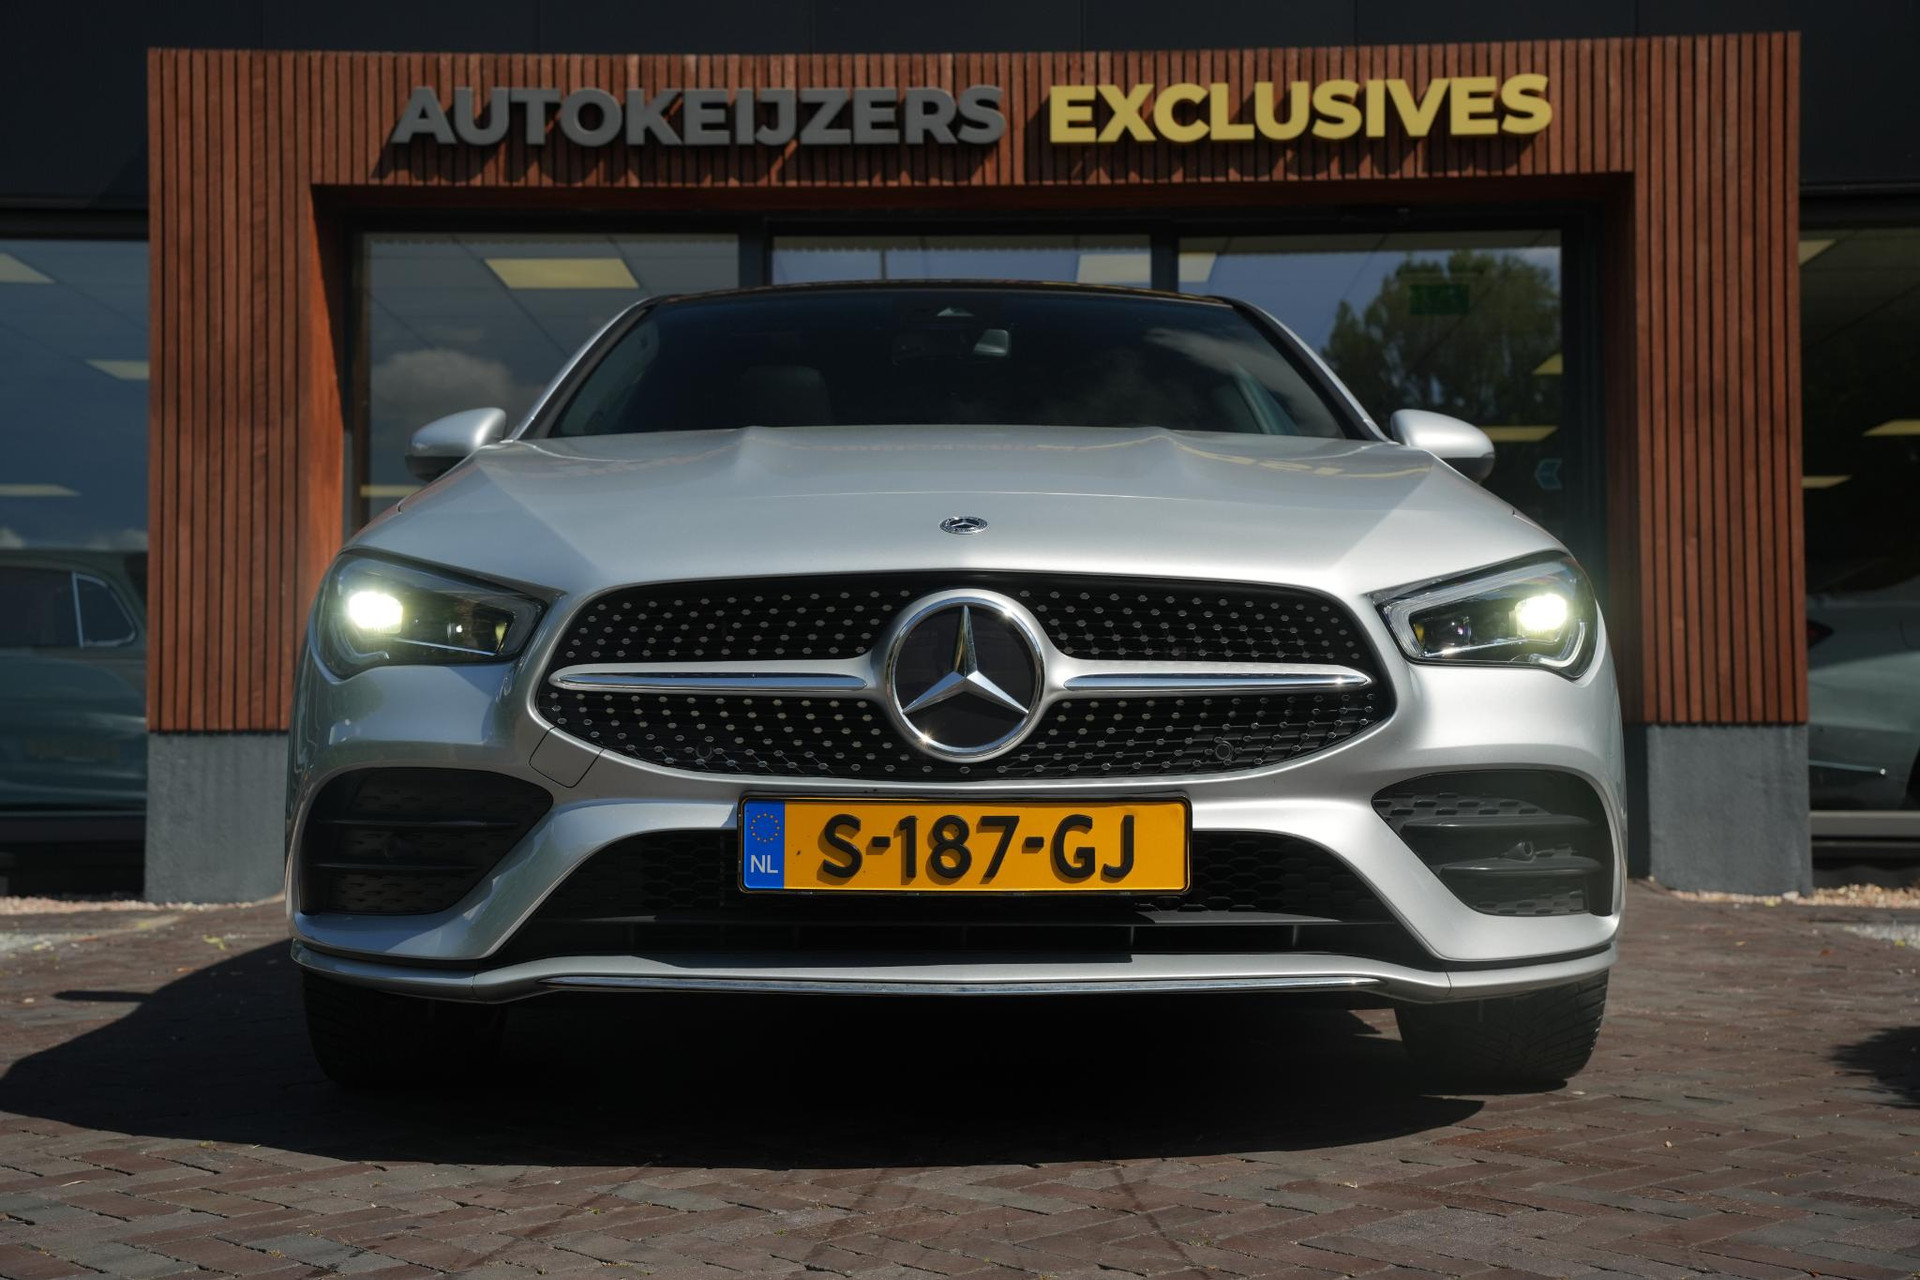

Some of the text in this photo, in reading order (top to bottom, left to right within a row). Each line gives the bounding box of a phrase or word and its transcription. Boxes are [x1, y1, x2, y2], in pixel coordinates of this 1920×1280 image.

[391, 73, 1553, 146] AUTOKEIJZERS EXCLUSIVES
[749, 813, 1136, 880] NL S-187-GJ
